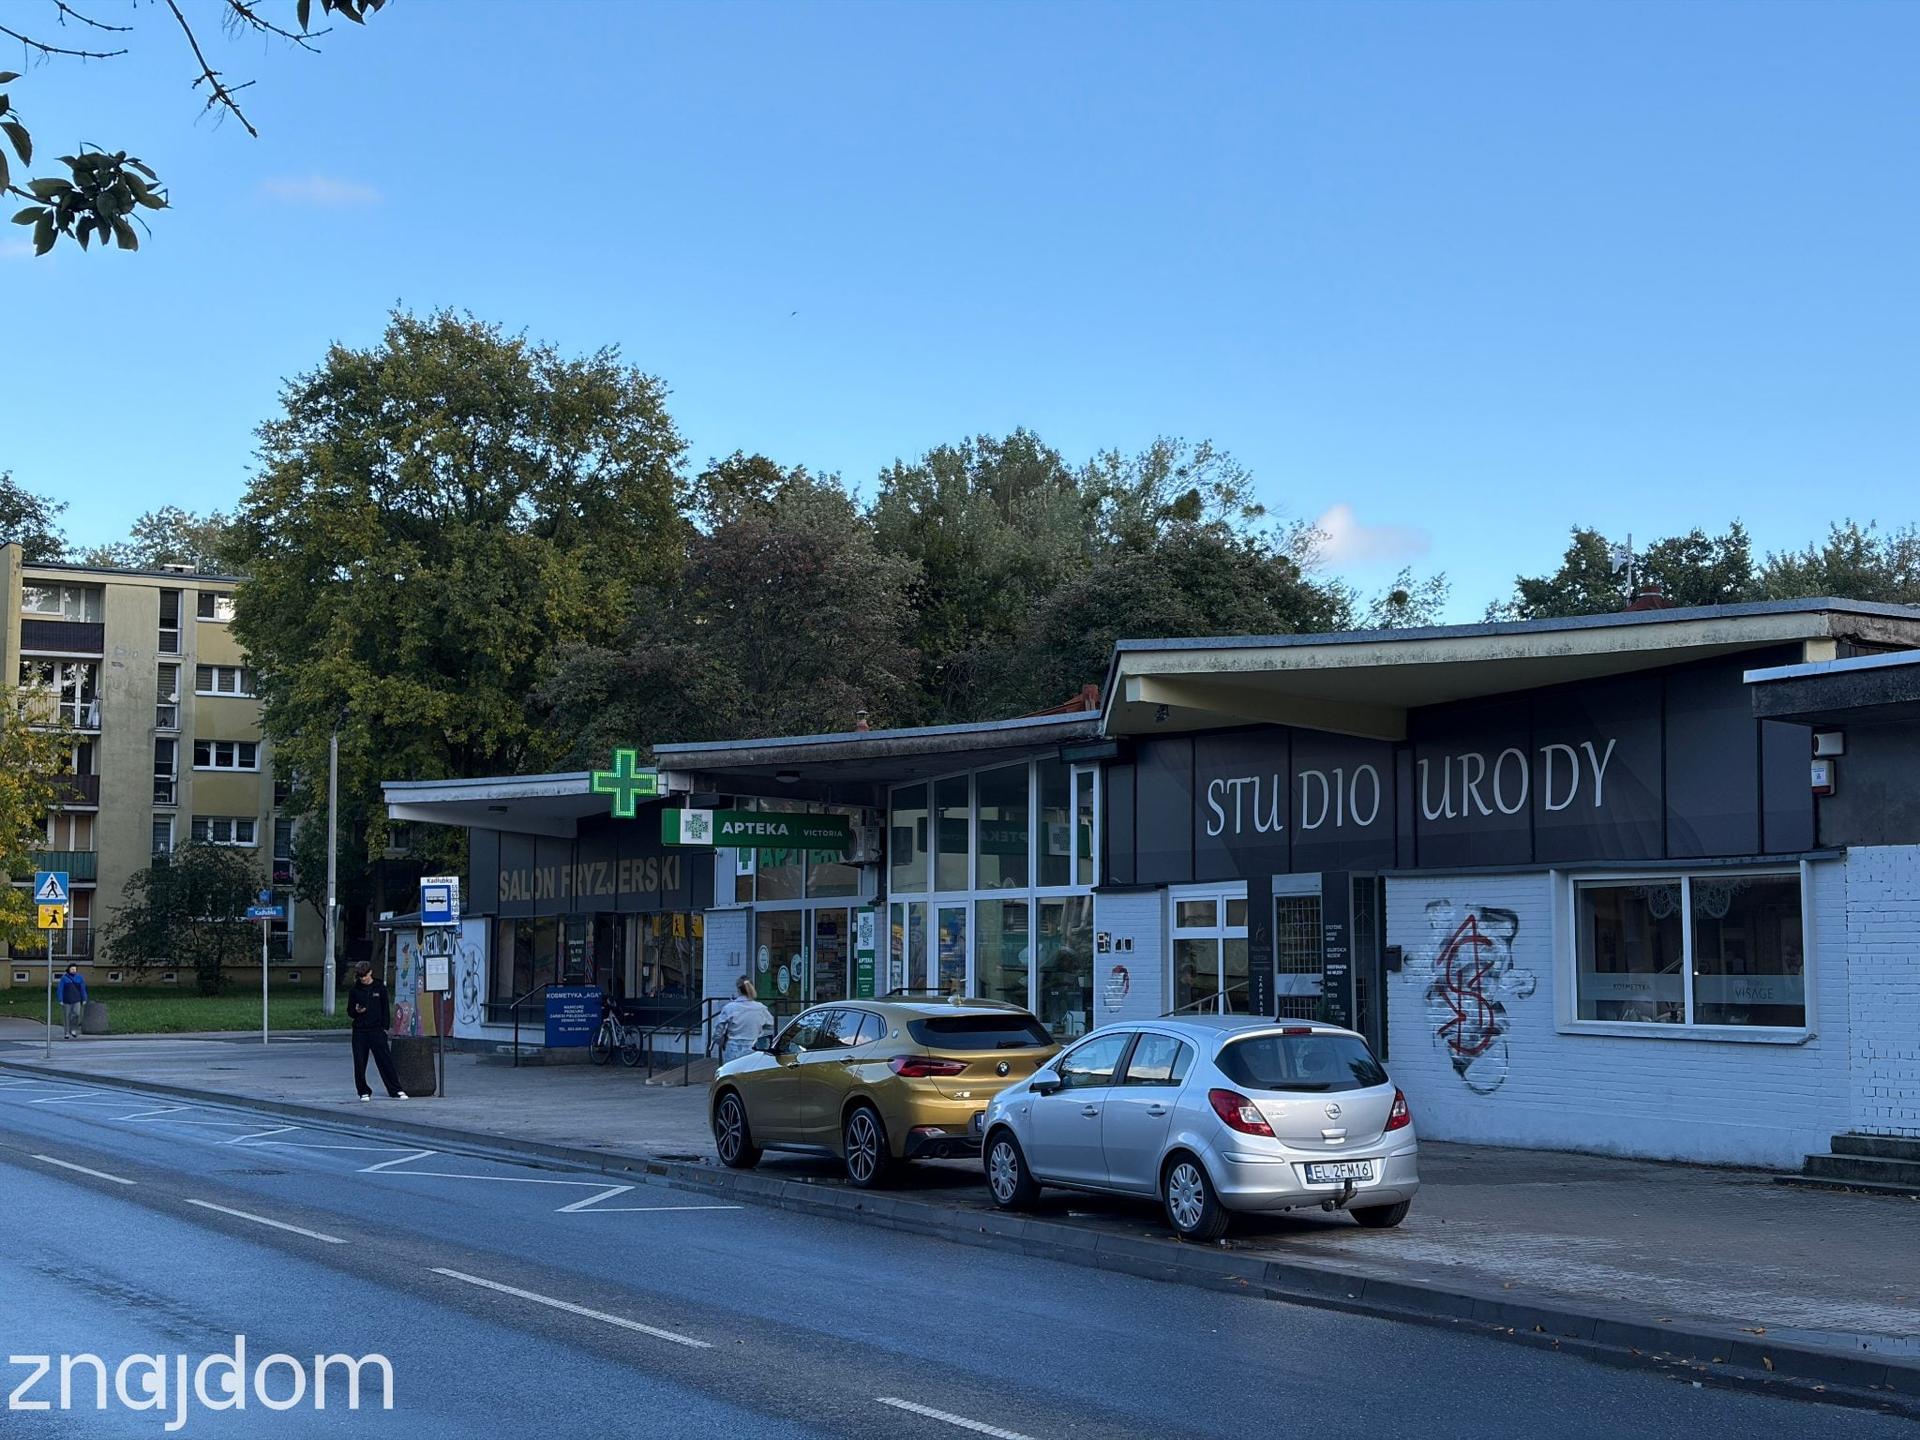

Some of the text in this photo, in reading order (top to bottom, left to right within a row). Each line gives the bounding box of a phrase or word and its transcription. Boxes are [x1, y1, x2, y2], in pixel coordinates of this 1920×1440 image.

[1206, 738, 1617, 837] STUDIO URODY
[721, 821, 843, 838] APTEKA VICTORIA
[499, 854, 681, 902] SALON FRYZJERSKI
[1735, 987, 1774, 1000] VISAGE
[1313, 1163, 1369, 1179] EL 2FM16
